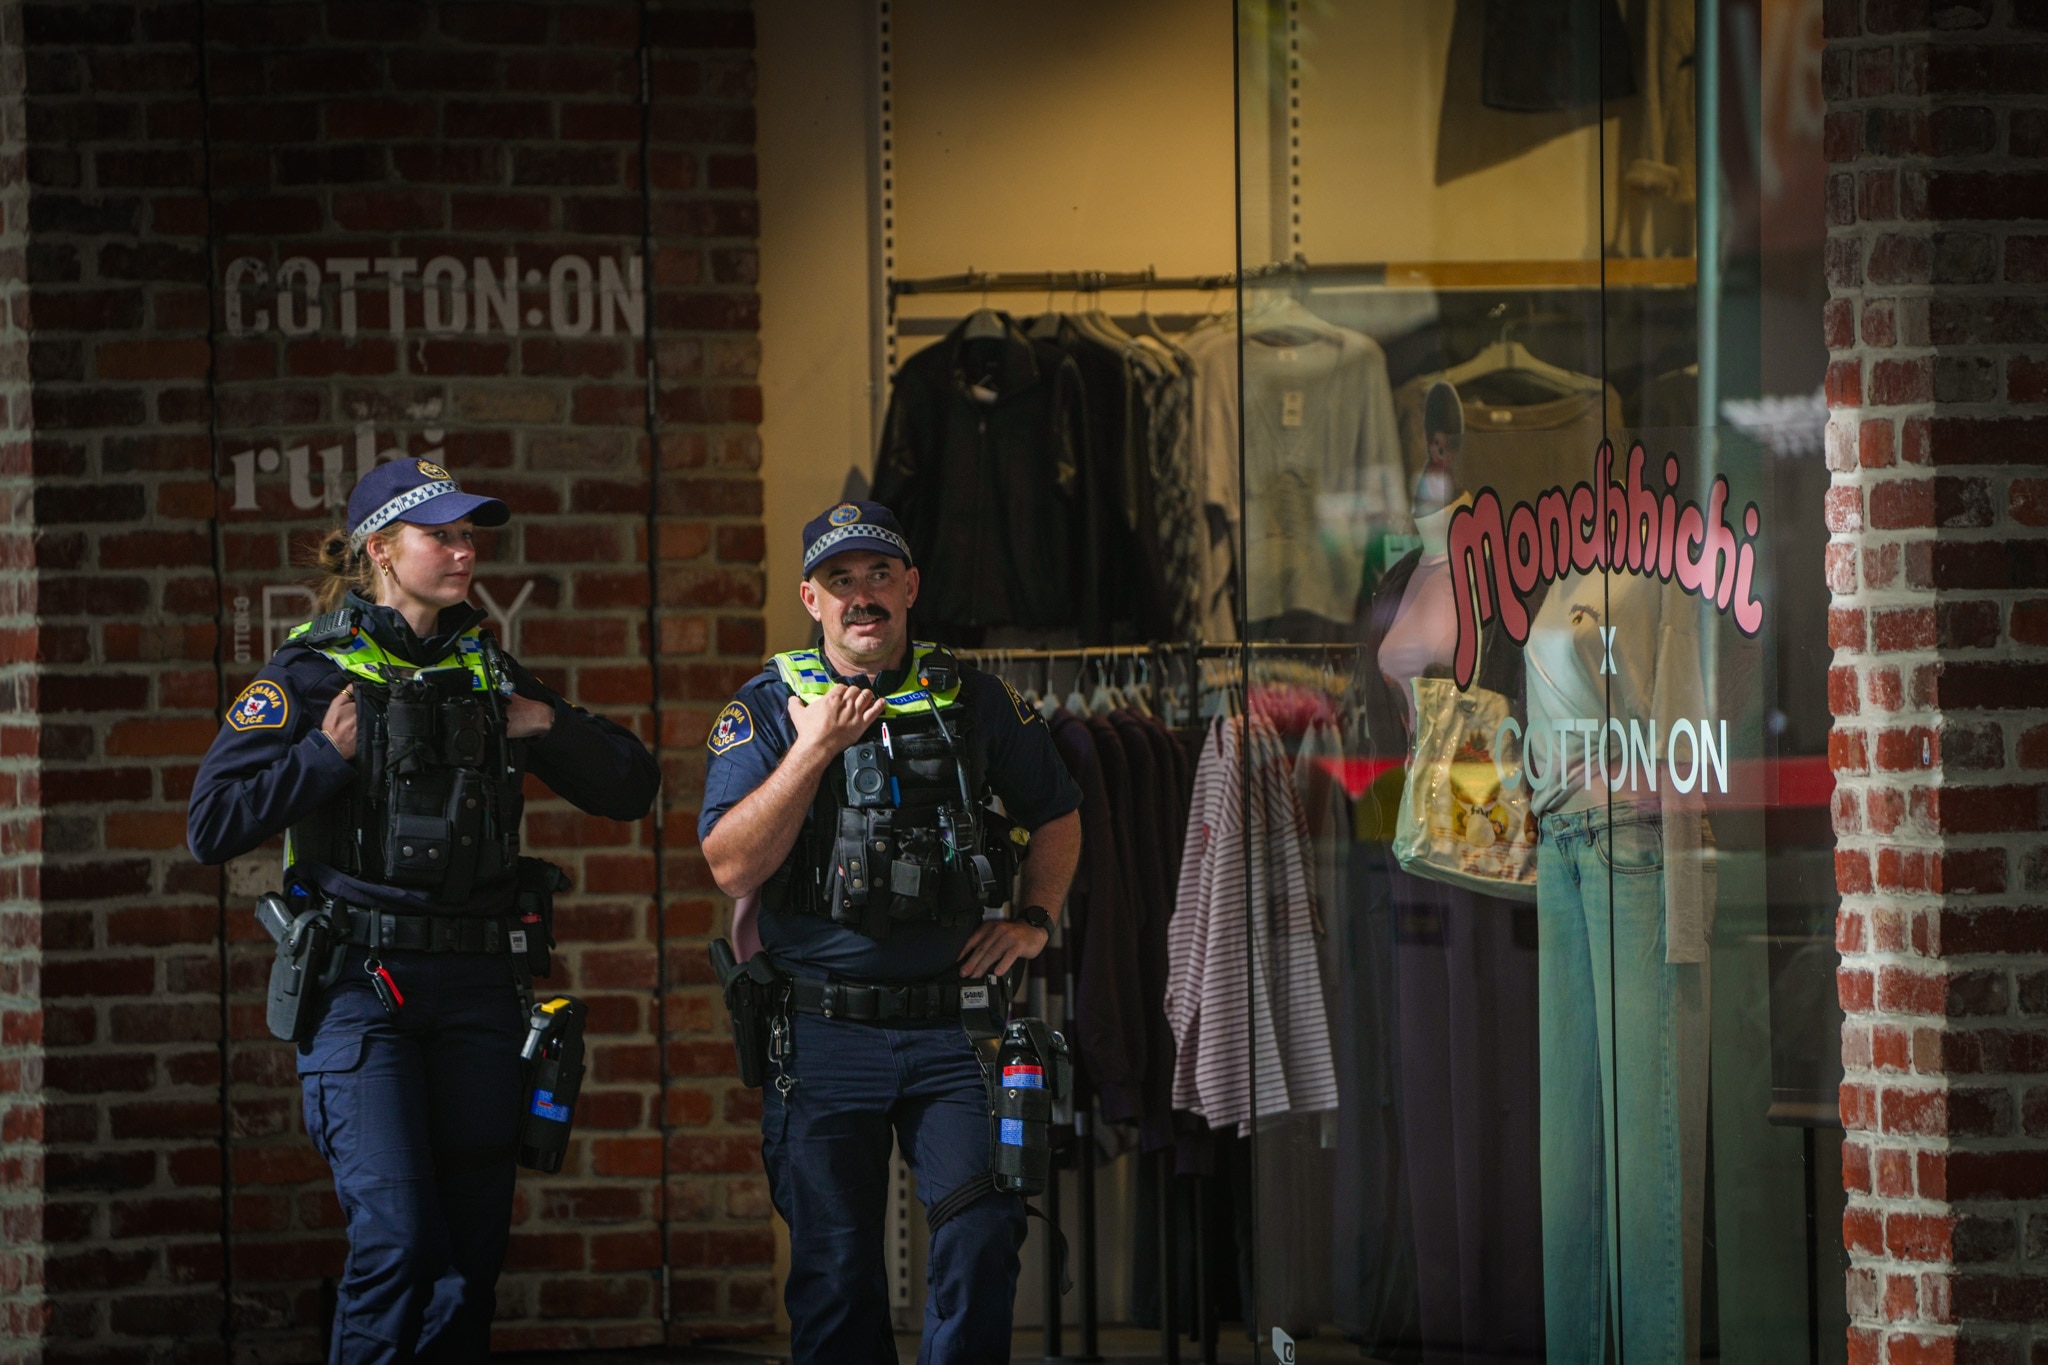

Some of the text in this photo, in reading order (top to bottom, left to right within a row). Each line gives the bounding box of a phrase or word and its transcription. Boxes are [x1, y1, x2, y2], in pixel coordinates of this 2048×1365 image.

[225, 254, 646, 338] COTTON:ON
[1448, 438, 1764, 692] Monchhichi
[234, 709, 266, 725] POLICE
[712, 731, 736, 747] POLICE
[1495, 717, 1728, 793] COTTON ON
